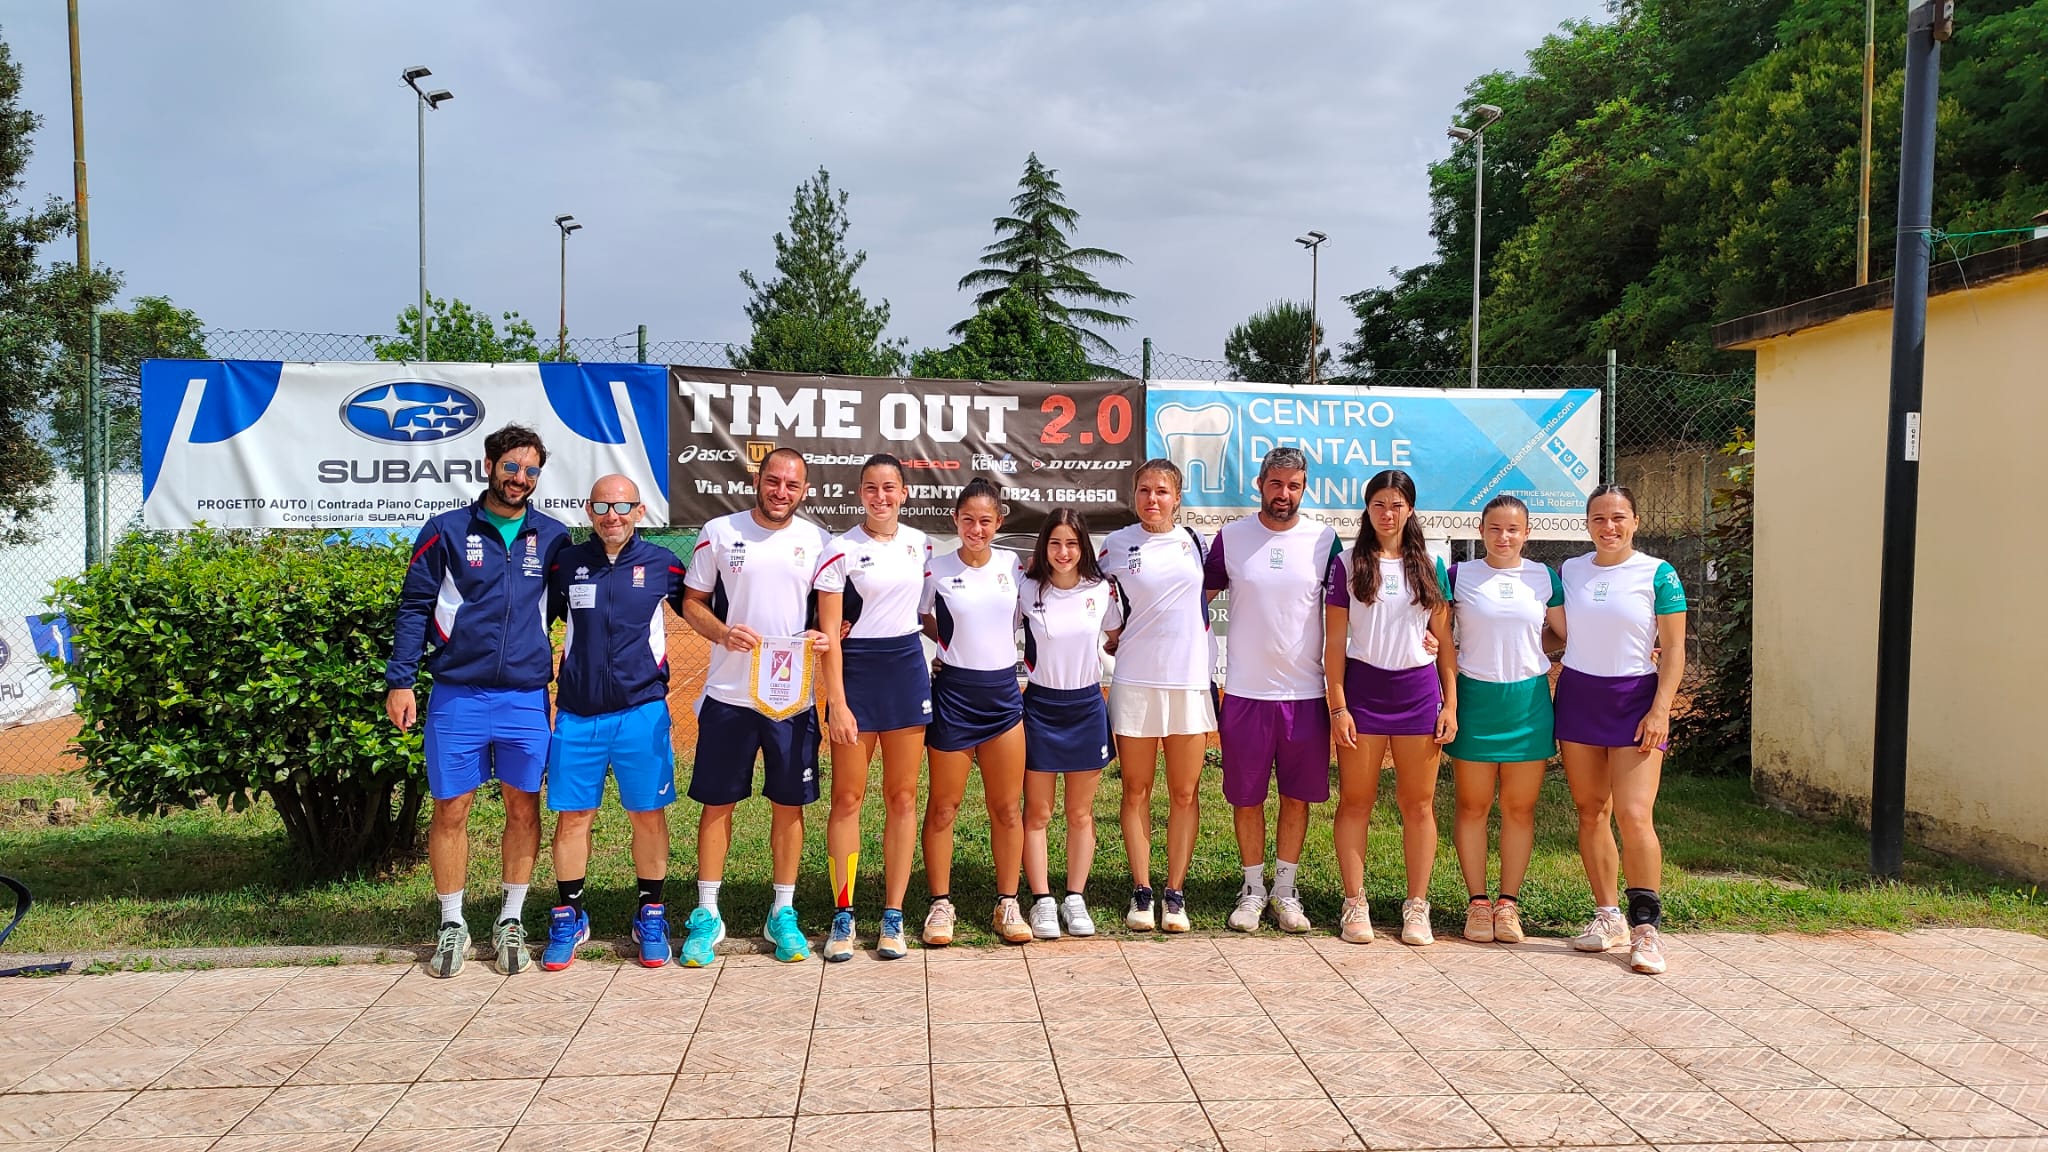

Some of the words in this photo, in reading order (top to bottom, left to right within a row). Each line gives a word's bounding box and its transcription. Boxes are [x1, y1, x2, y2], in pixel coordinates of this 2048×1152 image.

[679, 381, 862, 438] TIME
[879, 392, 1019, 445] OUT
[1040, 394, 1132, 445] 2.0
[1248, 398, 1394, 428] CENTRO
[899, 459, 960, 470] HEAD
[972, 459, 1018, 473] KENNEX
[1048, 460, 1133, 470] DUNLOP
[695, 480, 723, 494] Via
[823, 483, 844, 498] 12
[1000, 486, 1117, 503] 0824.1664650
[197, 498, 267, 510] PROGETTO
[270, 498, 308, 510] AUTO
[317, 498, 374, 510] Contrada
[377, 498, 412, 509] Piano
[414, 497, 468, 511] Cappelle
[1548, 498, 1585, 507] Roberto
[282, 513, 364, 522] Concessionaria
[368, 513, 425, 522] SUBARU
